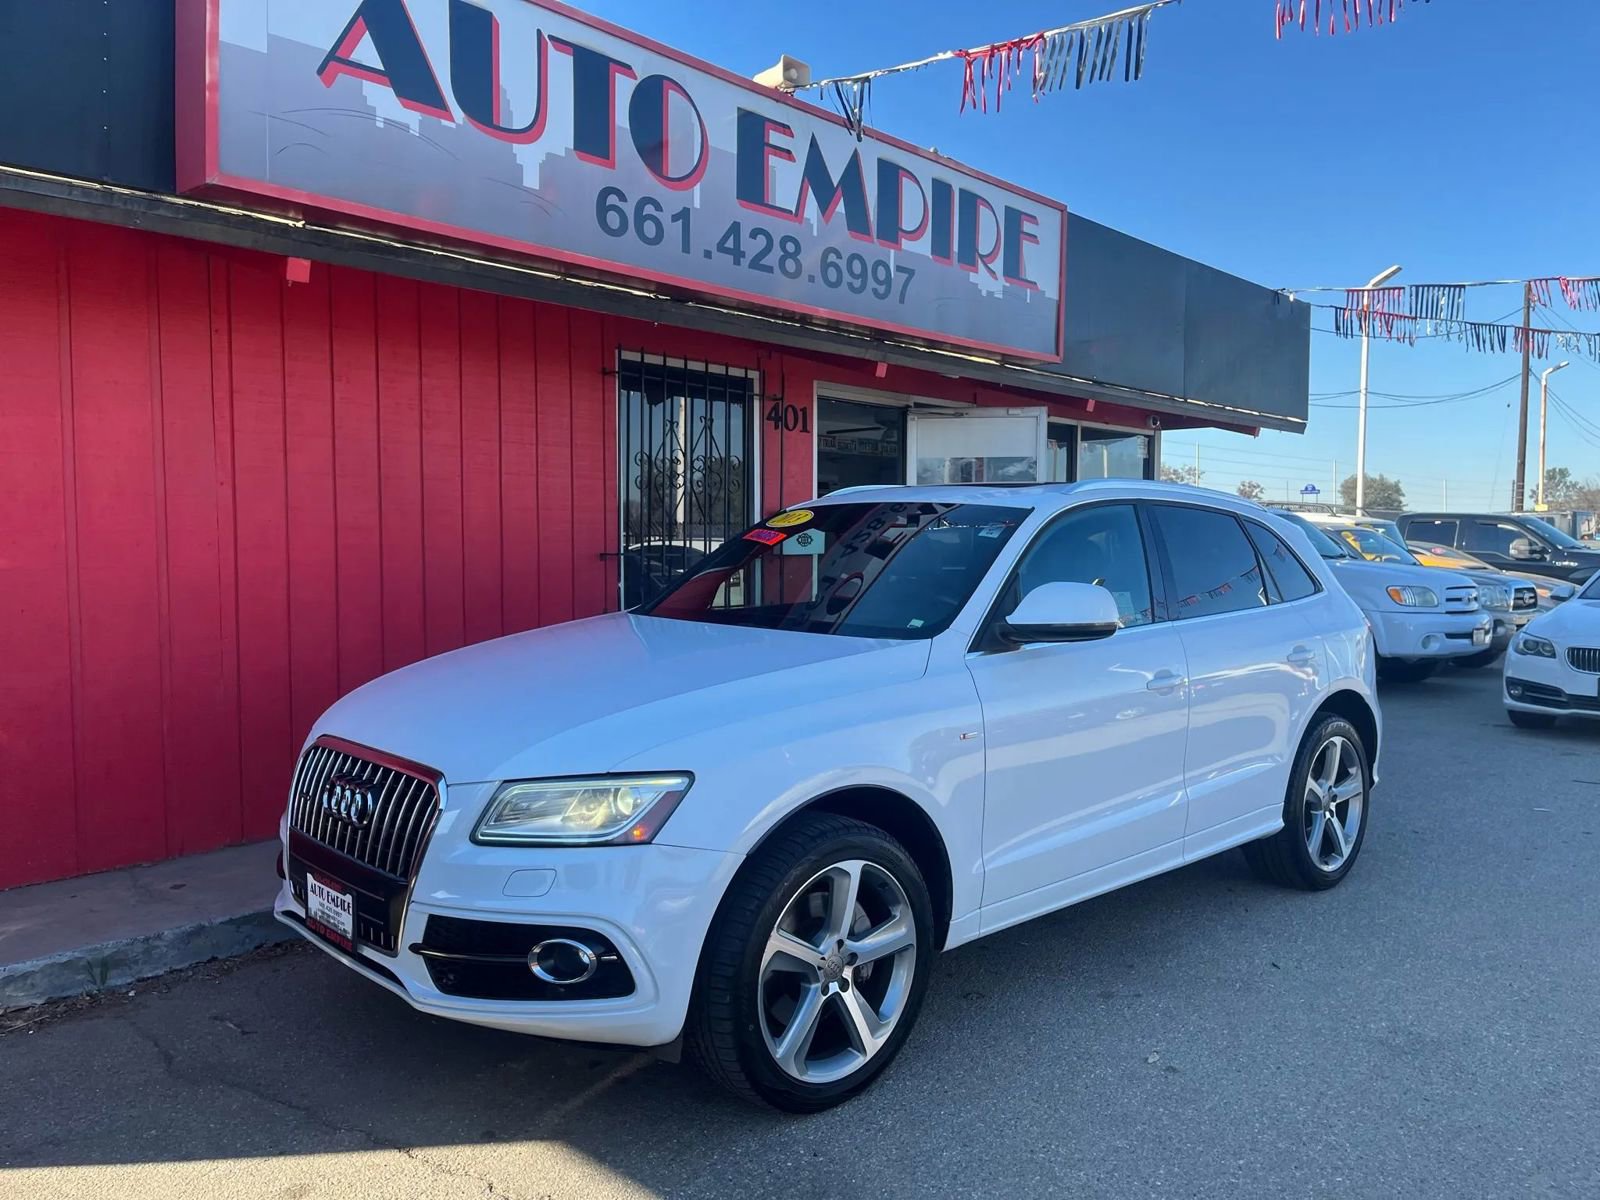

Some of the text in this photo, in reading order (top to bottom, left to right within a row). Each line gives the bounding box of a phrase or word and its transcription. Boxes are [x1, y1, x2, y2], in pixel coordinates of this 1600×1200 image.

[316, 0, 1041, 290] AUTO EMPIRE
[595, 185, 917, 304] 661.428.6997
[766, 402, 811, 433] 401
